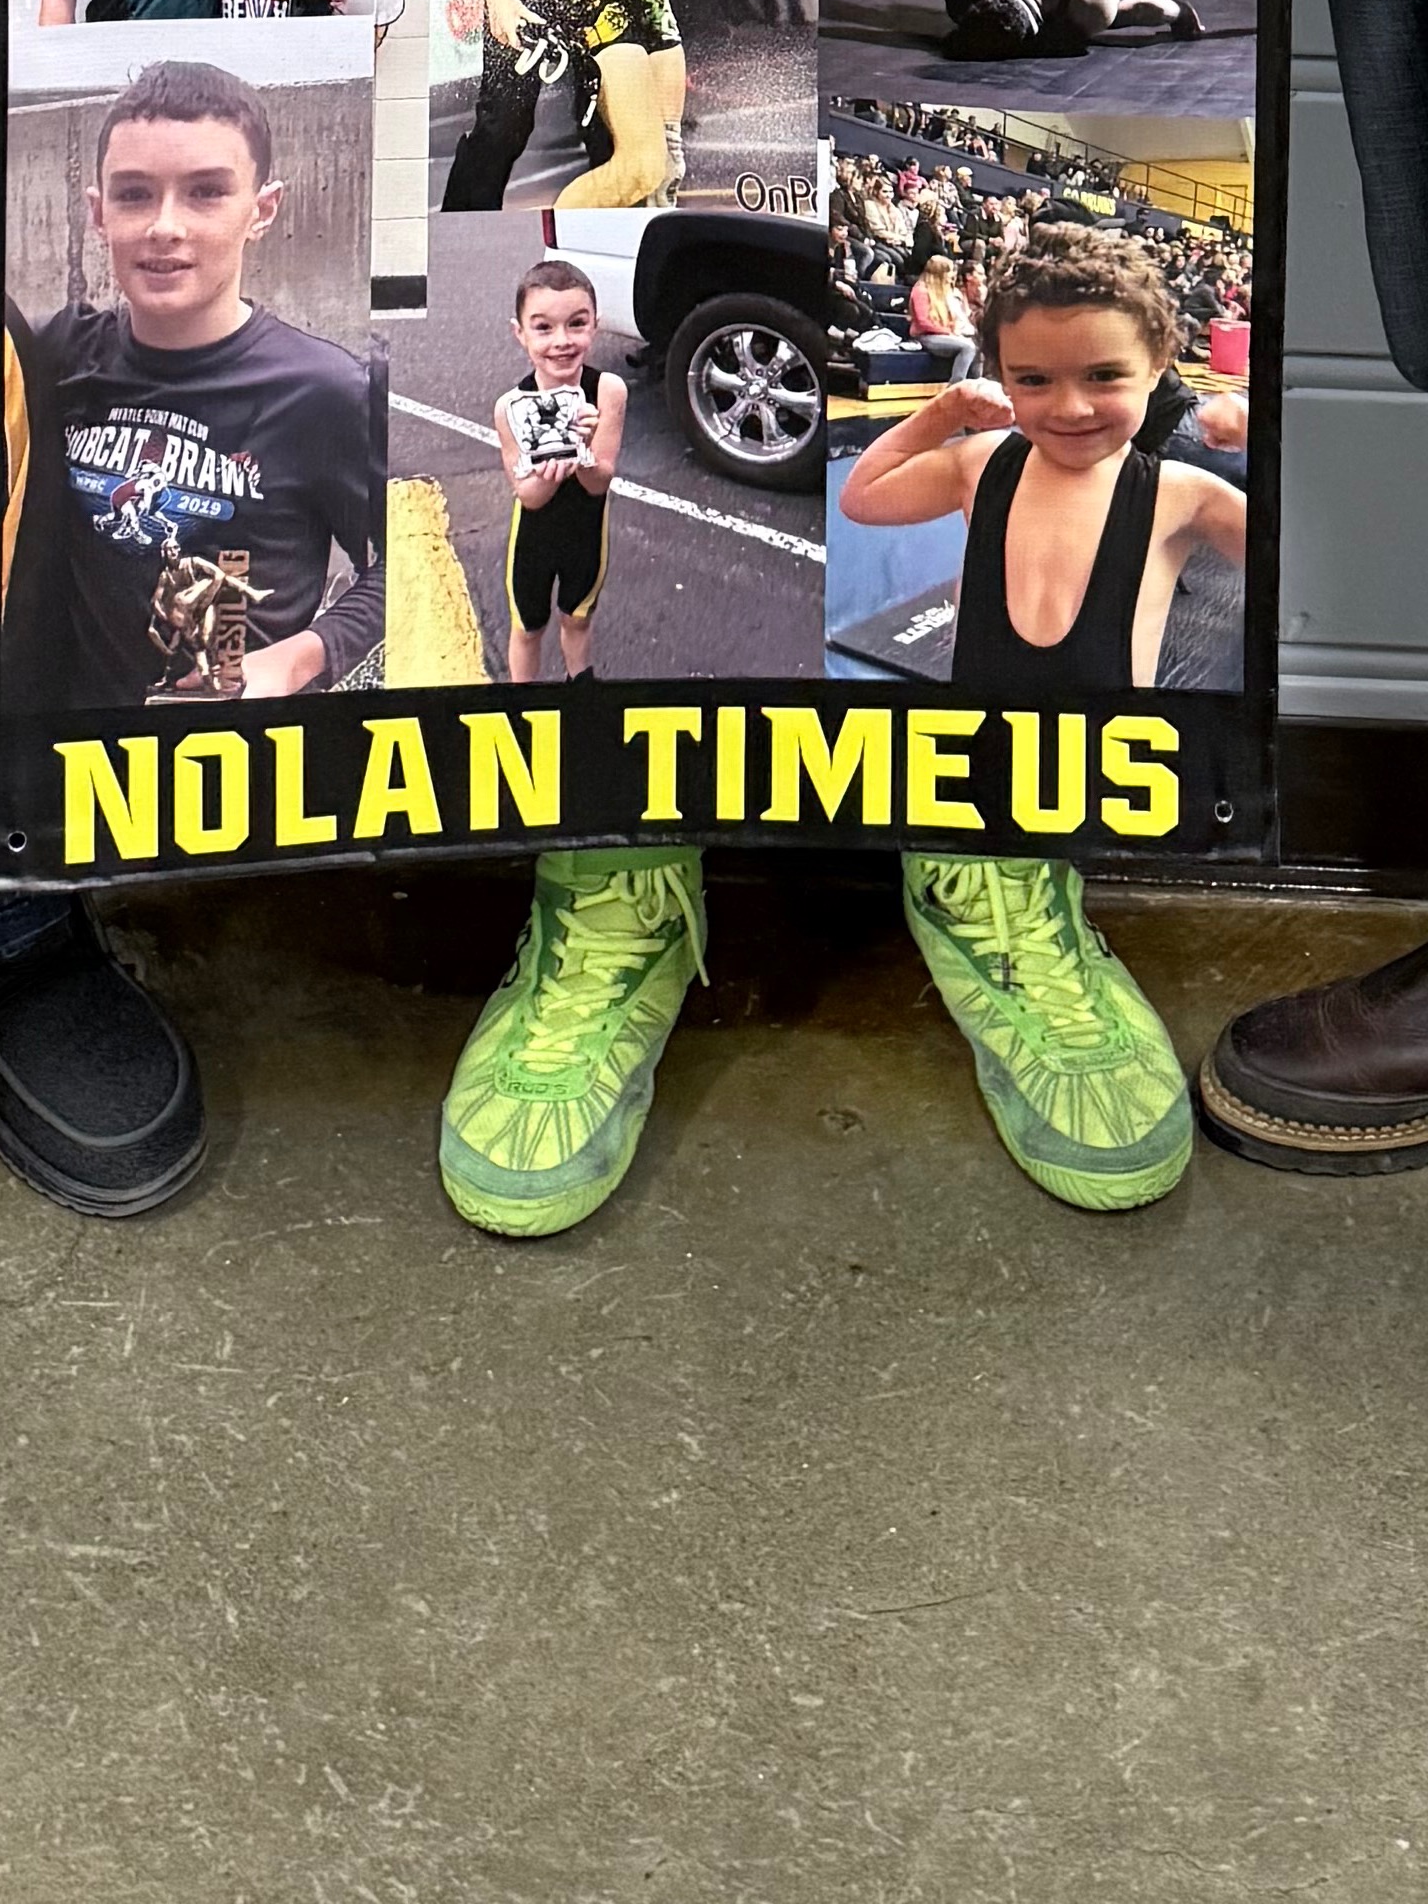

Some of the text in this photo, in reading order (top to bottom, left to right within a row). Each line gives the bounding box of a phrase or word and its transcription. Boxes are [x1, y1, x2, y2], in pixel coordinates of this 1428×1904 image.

[735, 172, 818, 214] OnP
[169, 412, 189, 432] MAT
[177, 495, 222, 517] 2019
[54, 709, 1178, 865] NOLAN TIMEUS
